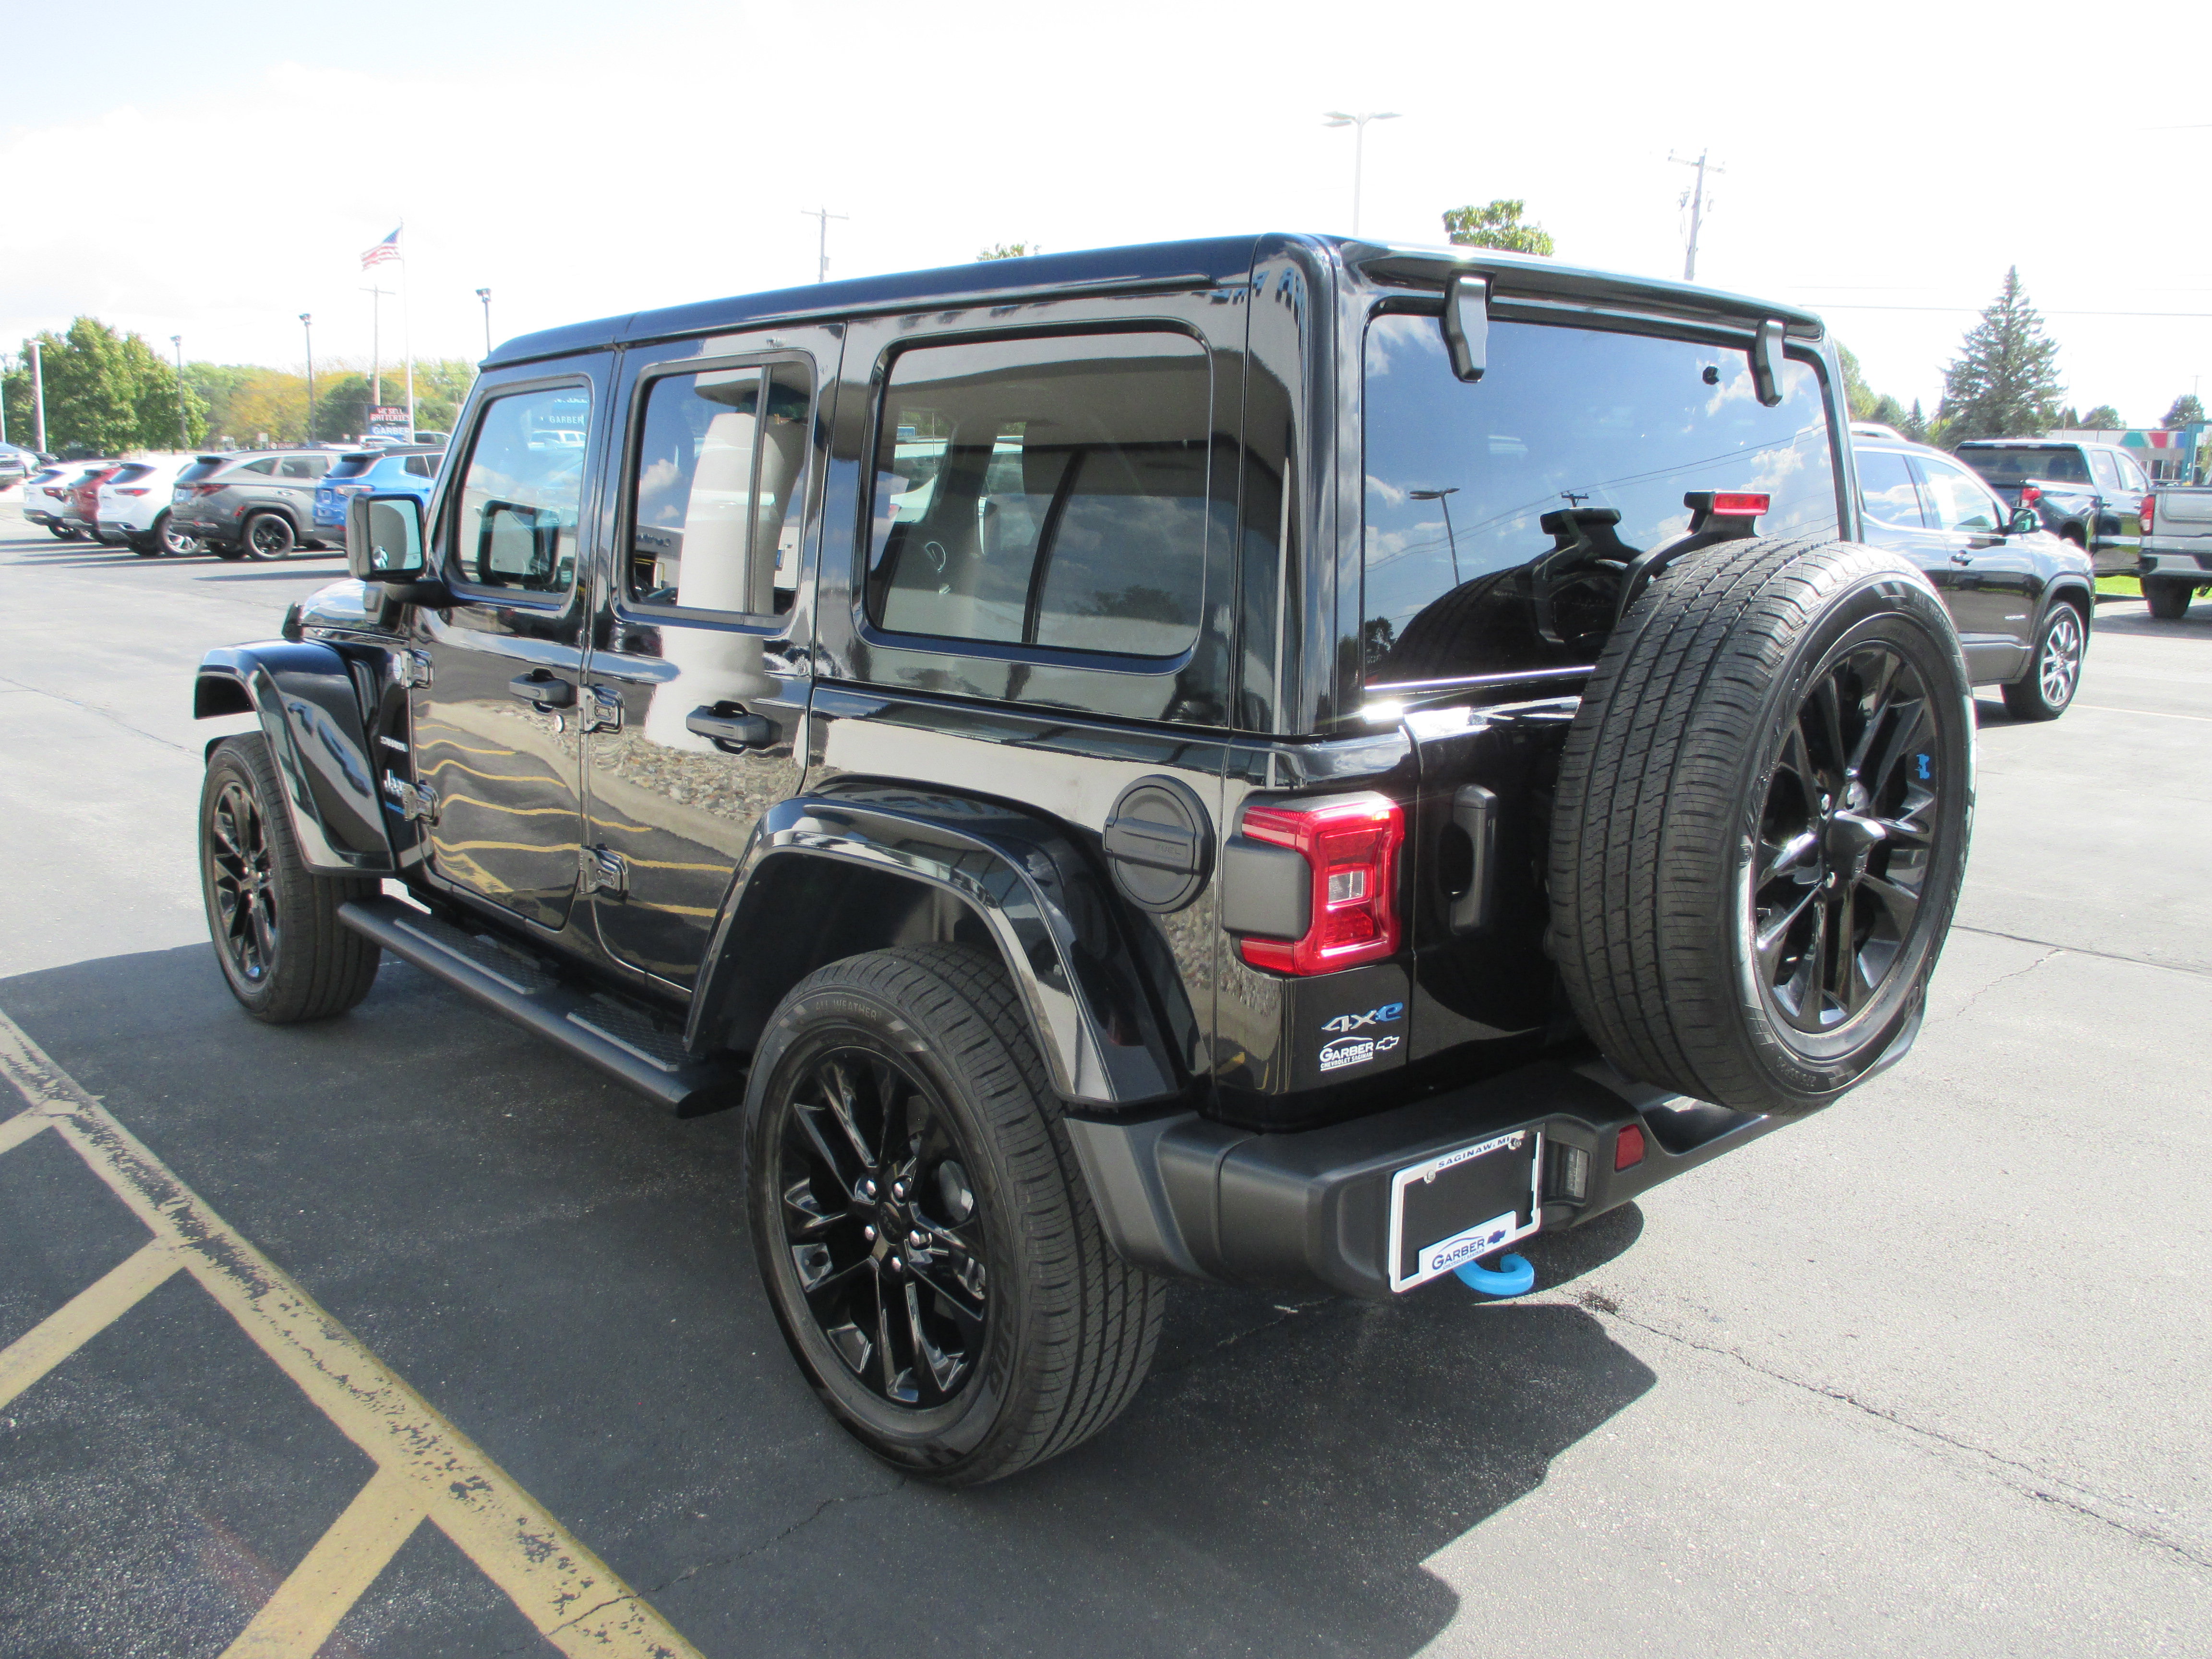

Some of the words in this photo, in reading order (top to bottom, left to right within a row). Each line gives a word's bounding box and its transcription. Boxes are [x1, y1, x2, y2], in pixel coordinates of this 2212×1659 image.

[372, 426, 410, 435] GARBER
[833, 999, 877, 1021] WEATHER
[1320, 1042, 1374, 1062] GARBER
[1321, 1057, 1351, 1069] CHEVROLET
[1351, 1051, 1373, 1062] SAGINAW
[1431, 1238, 1485, 1270] GARBER
